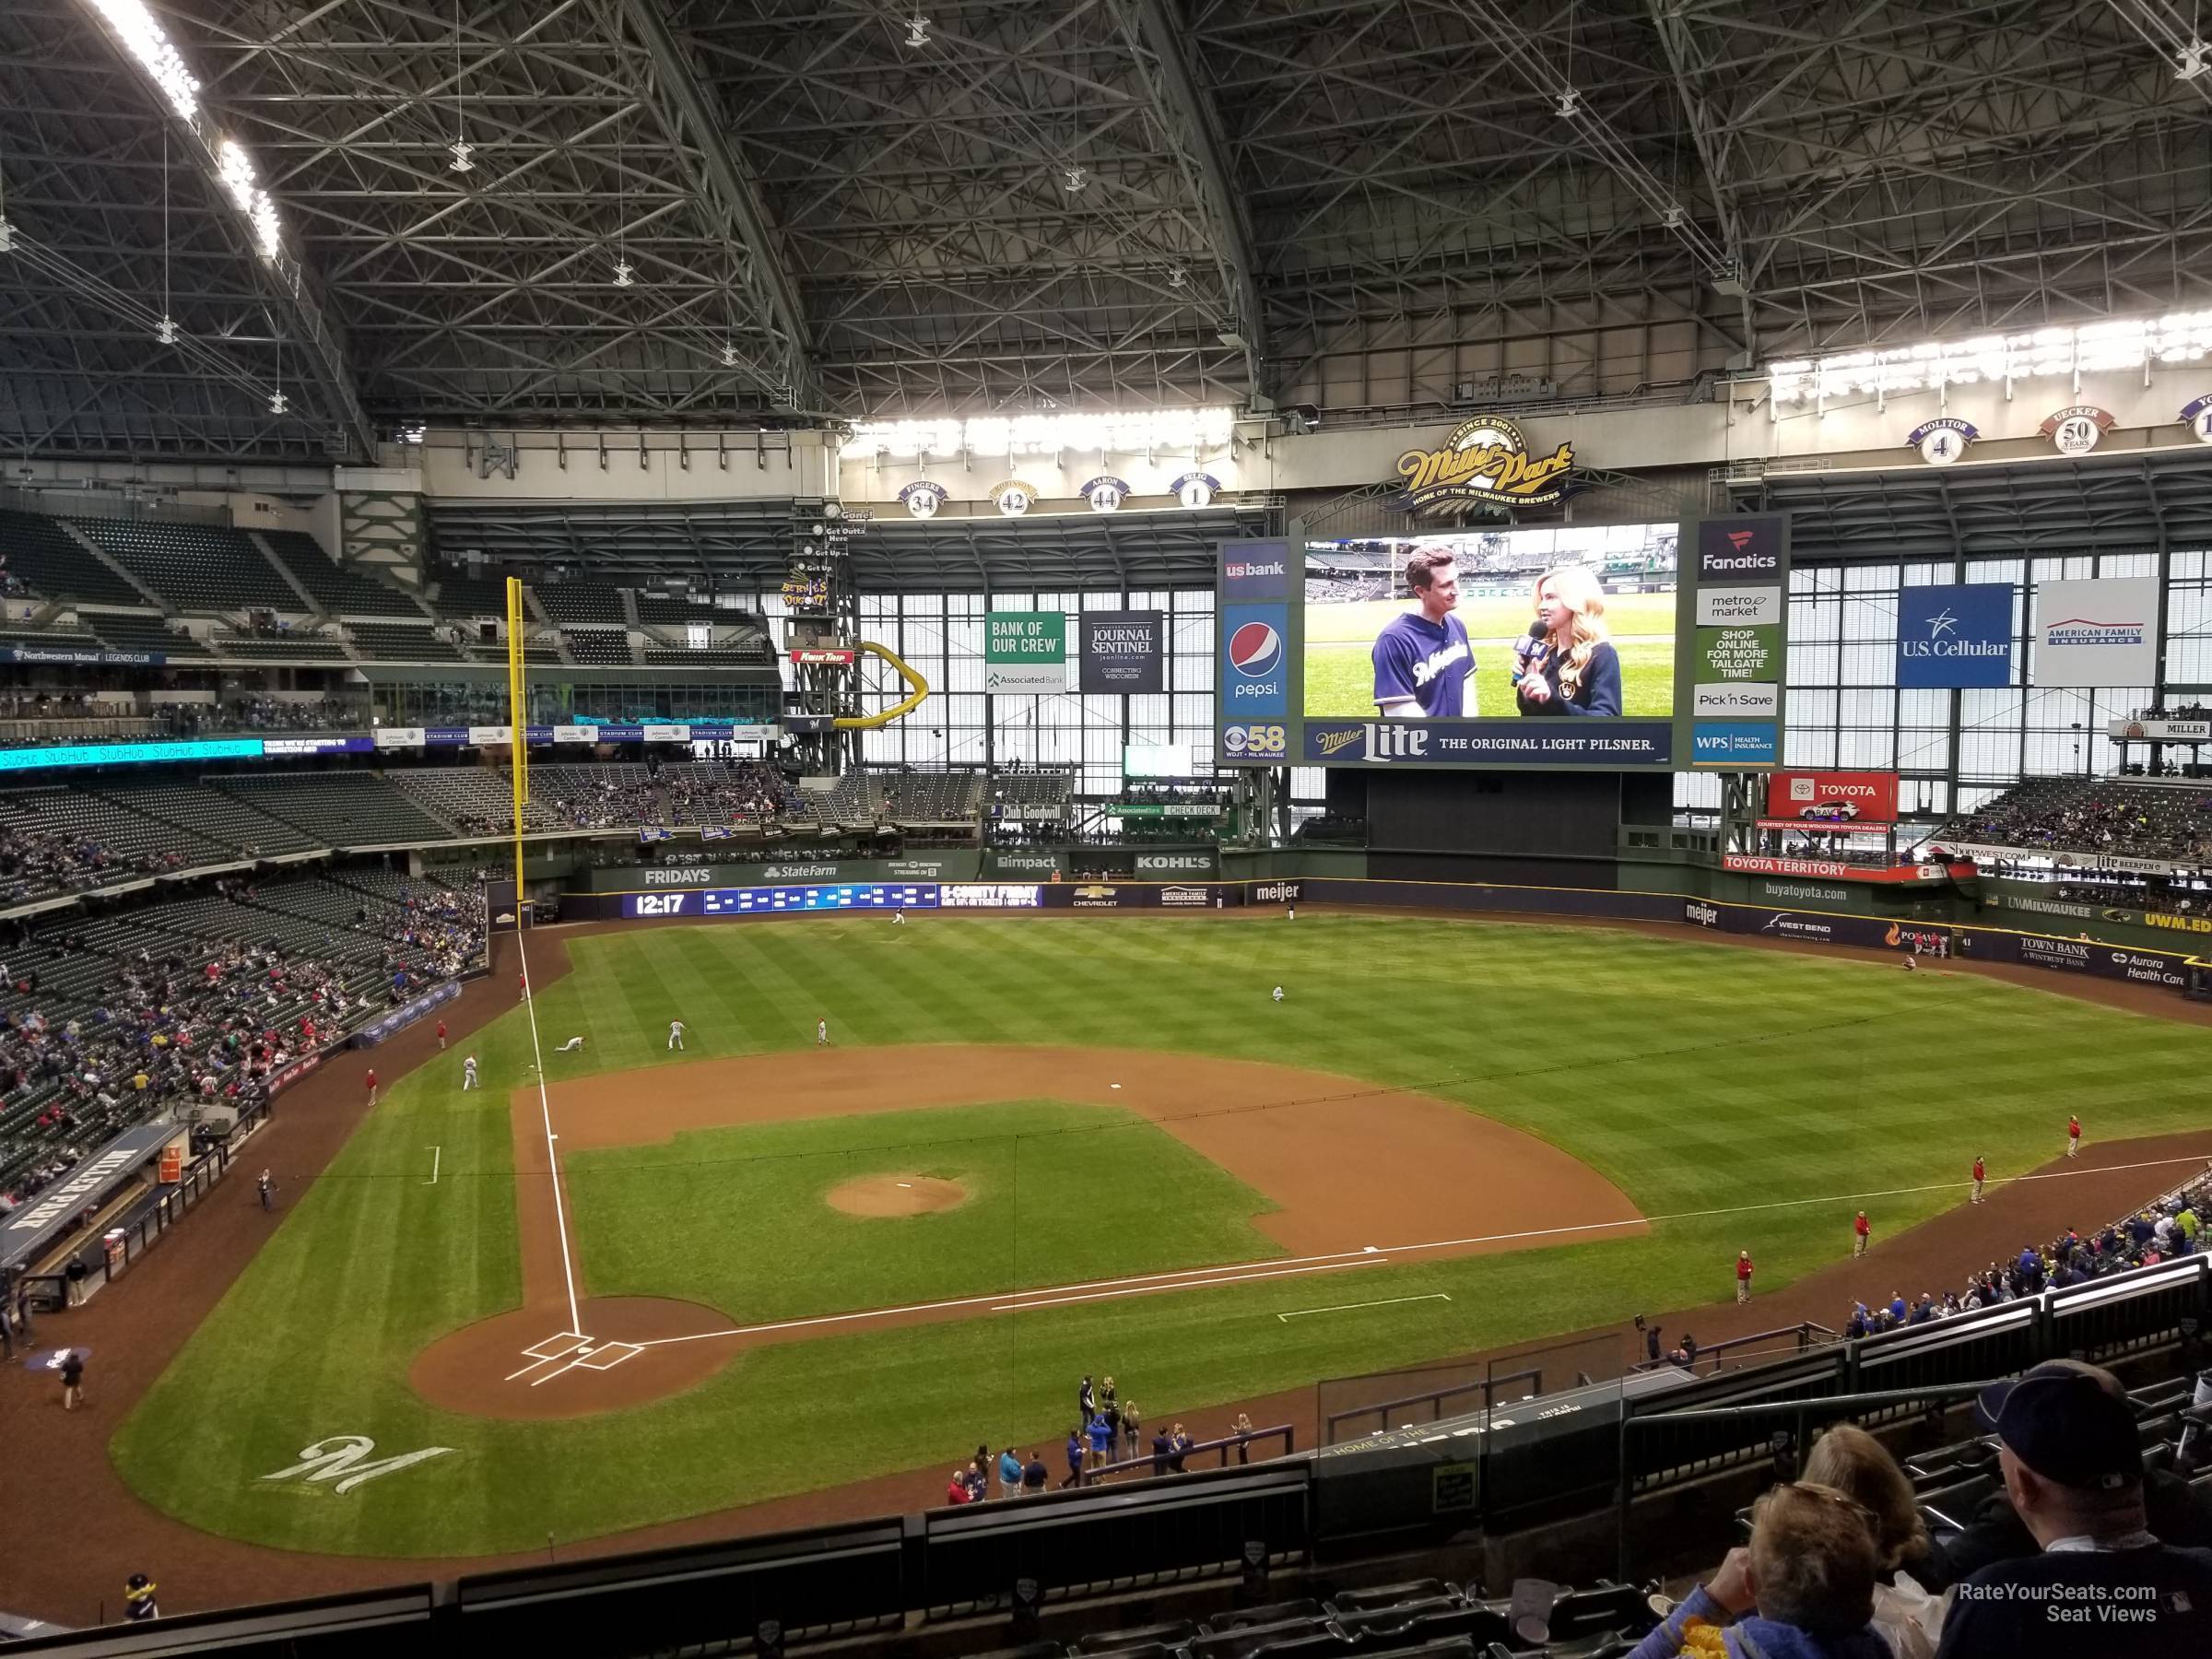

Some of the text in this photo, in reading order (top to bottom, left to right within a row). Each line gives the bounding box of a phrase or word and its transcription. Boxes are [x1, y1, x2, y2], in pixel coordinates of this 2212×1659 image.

[2054, 407, 2099, 422] UECKER
[1457, 418, 1512, 437] SINCE 2001
[1918, 419, 1968, 436] MOLITOR
[2063, 421, 2089, 441] 50
[1934, 437, 1947, 455] 4
[1398, 441, 1572, 493] Miller Park
[908, 482, 939, 493] FINGERS
[1092, 478, 1118, 488] AARON
[1002, 494, 1024, 510] 42
[1094, 490, 1116, 508] 44
[1193, 488, 1201, 504] 1
[1413, 490, 1435, 506] HOME
[1450, 488, 1466, 496] THE
[1468, 488, 1516, 504] MILWAUKEE
[1518, 491, 1560, 504] BREWERS
[912, 496, 935, 511] 34
[841, 511, 873, 519] Gone!
[1703, 554, 1776, 570] Fanatics
[1712, 595, 1752, 606] metro
[1712, 606, 1759, 617] market
[992, 621, 1043, 636] BANK OF
[1091, 629, 1153, 642] JOURNAL
[1722, 630, 1755, 640] SHOP
[2048, 628, 2142, 638] AMERICAN FAMILY
[992, 639, 1056, 653] OUR CREW
[1091, 642, 1153, 653] SENTINEL
[1716, 640, 1759, 649] ONLINE
[1901, 639, 2008, 657] U.S. Cellular
[24, 651, 73, 661] Northwestern
[105, 653, 133, 662] LEGENDS
[1707, 649, 1769, 659] FOR MORE
[1710, 659, 1764, 668] TAILGATE
[1721, 668, 1752, 678] TIME!
[1700, 695, 1726, 705] Pick
[1740, 695, 1773, 705] Save
[2167, 724, 2206, 734] MILLER
[1247, 725, 1286, 752] 58
[1316, 723, 1655, 761] Miller Lite THE ORIGINAL LIGHT PILSNER.
[1697, 736, 1728, 748] WPS
[44, 750, 89, 763] StubHub
[100, 748, 144, 760] StubHub
[153, 746, 194, 758] StubHub
[202, 744, 241, 754] StubHub
[1819, 784, 1877, 796] TOYOTA
[1003, 804, 1061, 819] Club Goodwill
[1170, 806, 1216, 815] CHECK DECK
[1816, 808, 1841, 817] RAV4
[1008, 855, 1056, 870] impact
[1136, 856, 1211, 868] KOHL'S
[1726, 856, 1846, 876] TOYOTA TERRITORY
[2119, 861, 2154, 870] BEERPEN
[645, 869, 711, 884] FRIDAYS
[1256, 882, 1299, 901] meijer
[1765, 882, 1846, 900] buyatoyota.com
[637, 894, 685, 914] 12:17
[1686, 903, 1717, 924] meijer
[1779, 922, 1831, 934] WEST BEND
[2020, 937, 2089, 959] TOWN BANK
[2029, 953, 2065, 964] WINTRUST
[2066, 959, 2086, 967] BANK
[2129, 955, 2163, 969] Aurora
[2127, 968, 2160, 982] Health
[1333, 1429, 1430, 1455] HOME OF THE
